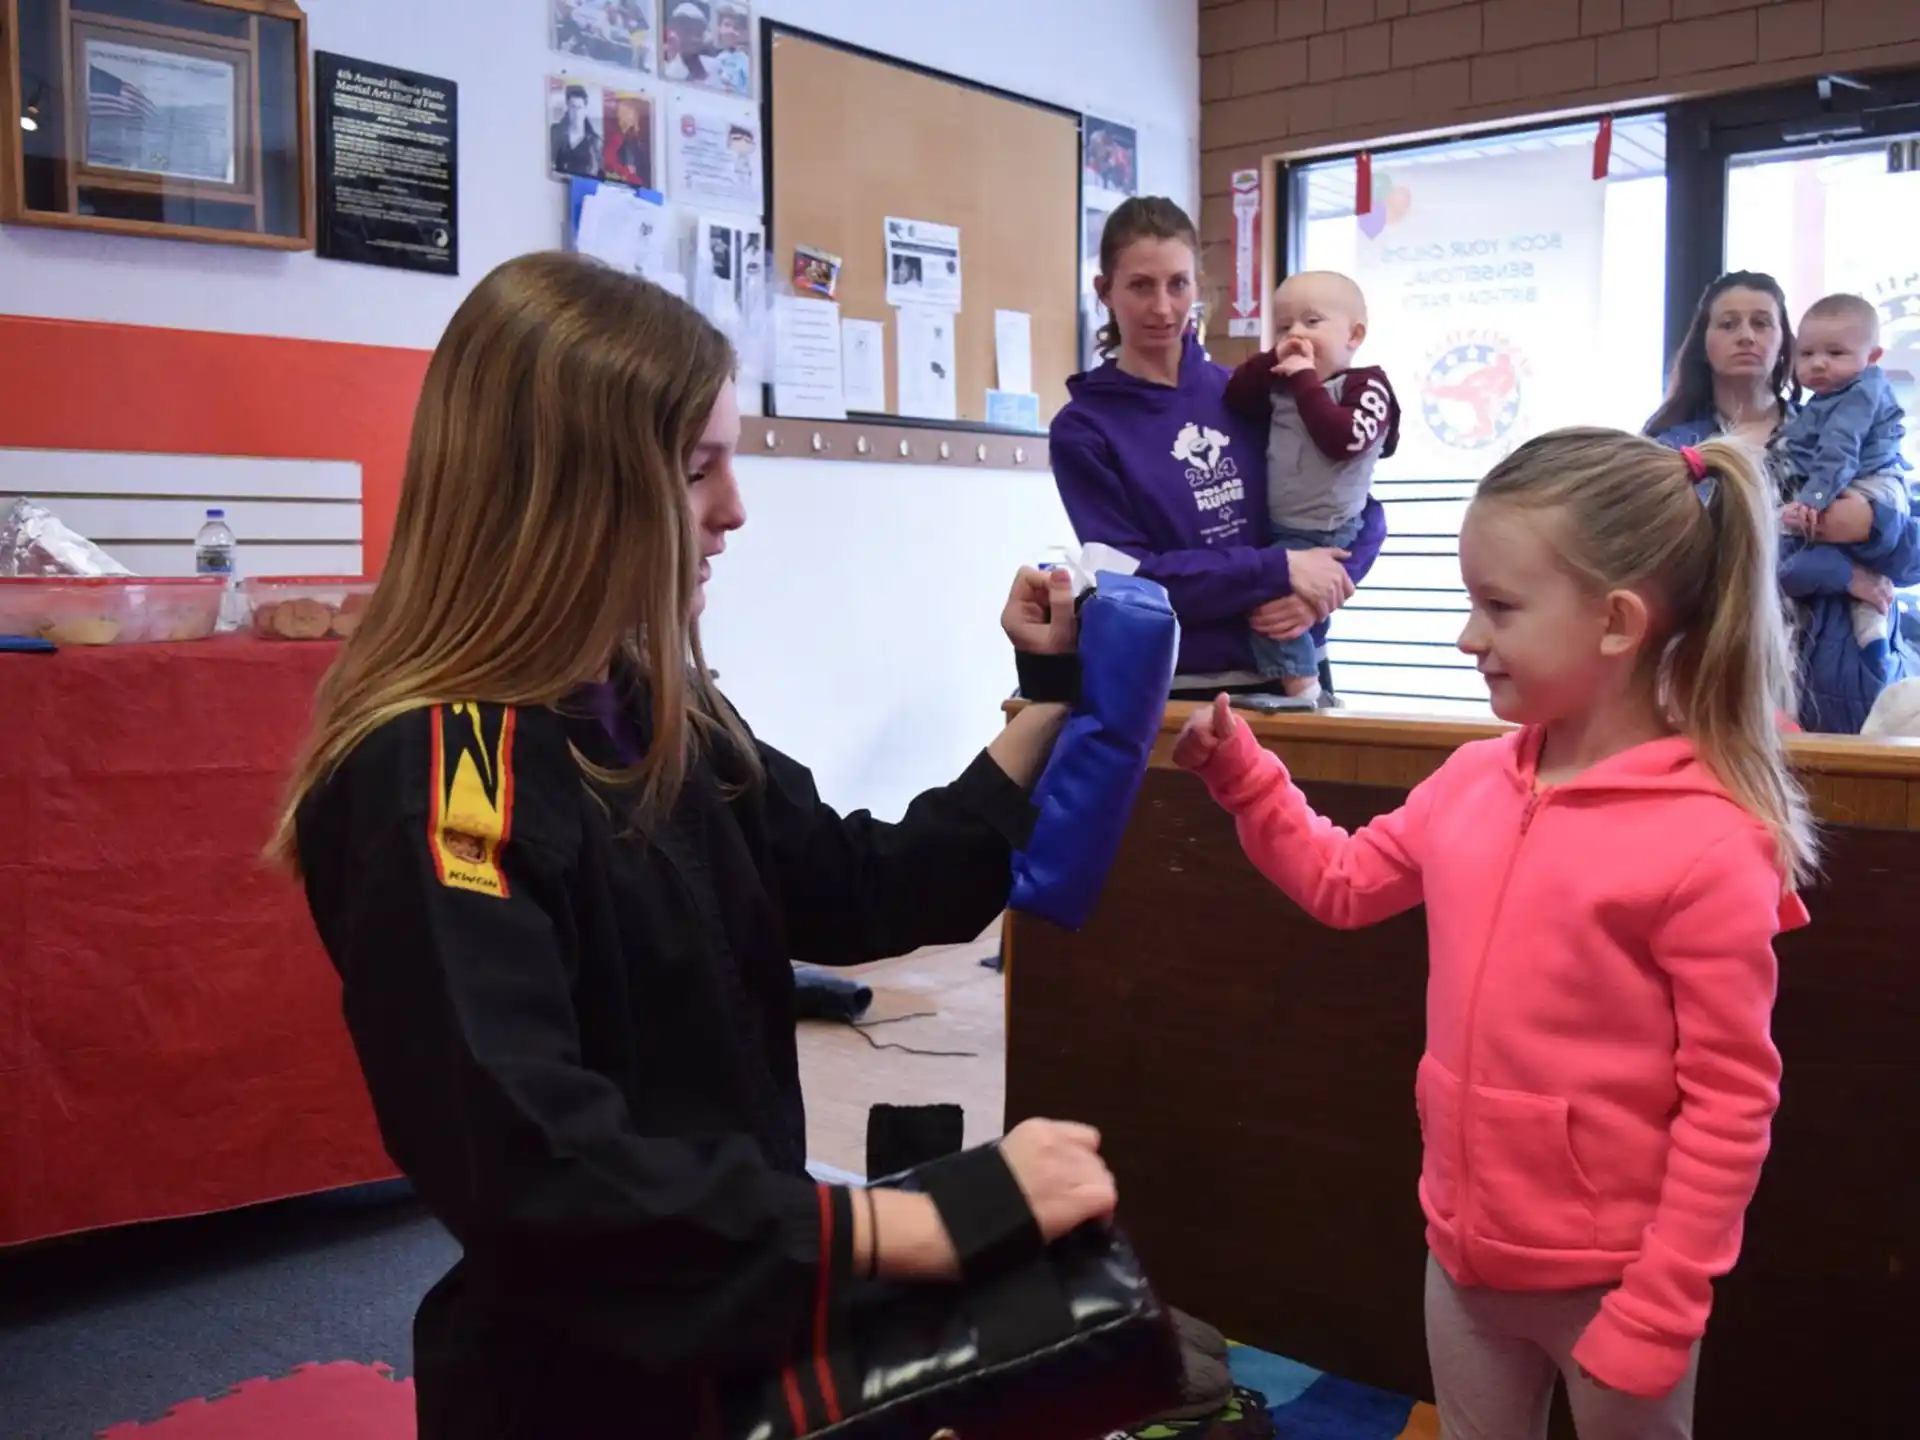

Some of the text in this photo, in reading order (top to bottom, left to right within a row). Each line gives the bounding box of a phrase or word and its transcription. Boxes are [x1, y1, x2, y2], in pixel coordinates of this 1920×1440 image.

[335, 79, 371, 95] Martial
[371, 87, 392, 100] Arts
[1193, 478, 1243, 499] POLAR
[1196, 487, 1245, 512] PLUNGE
